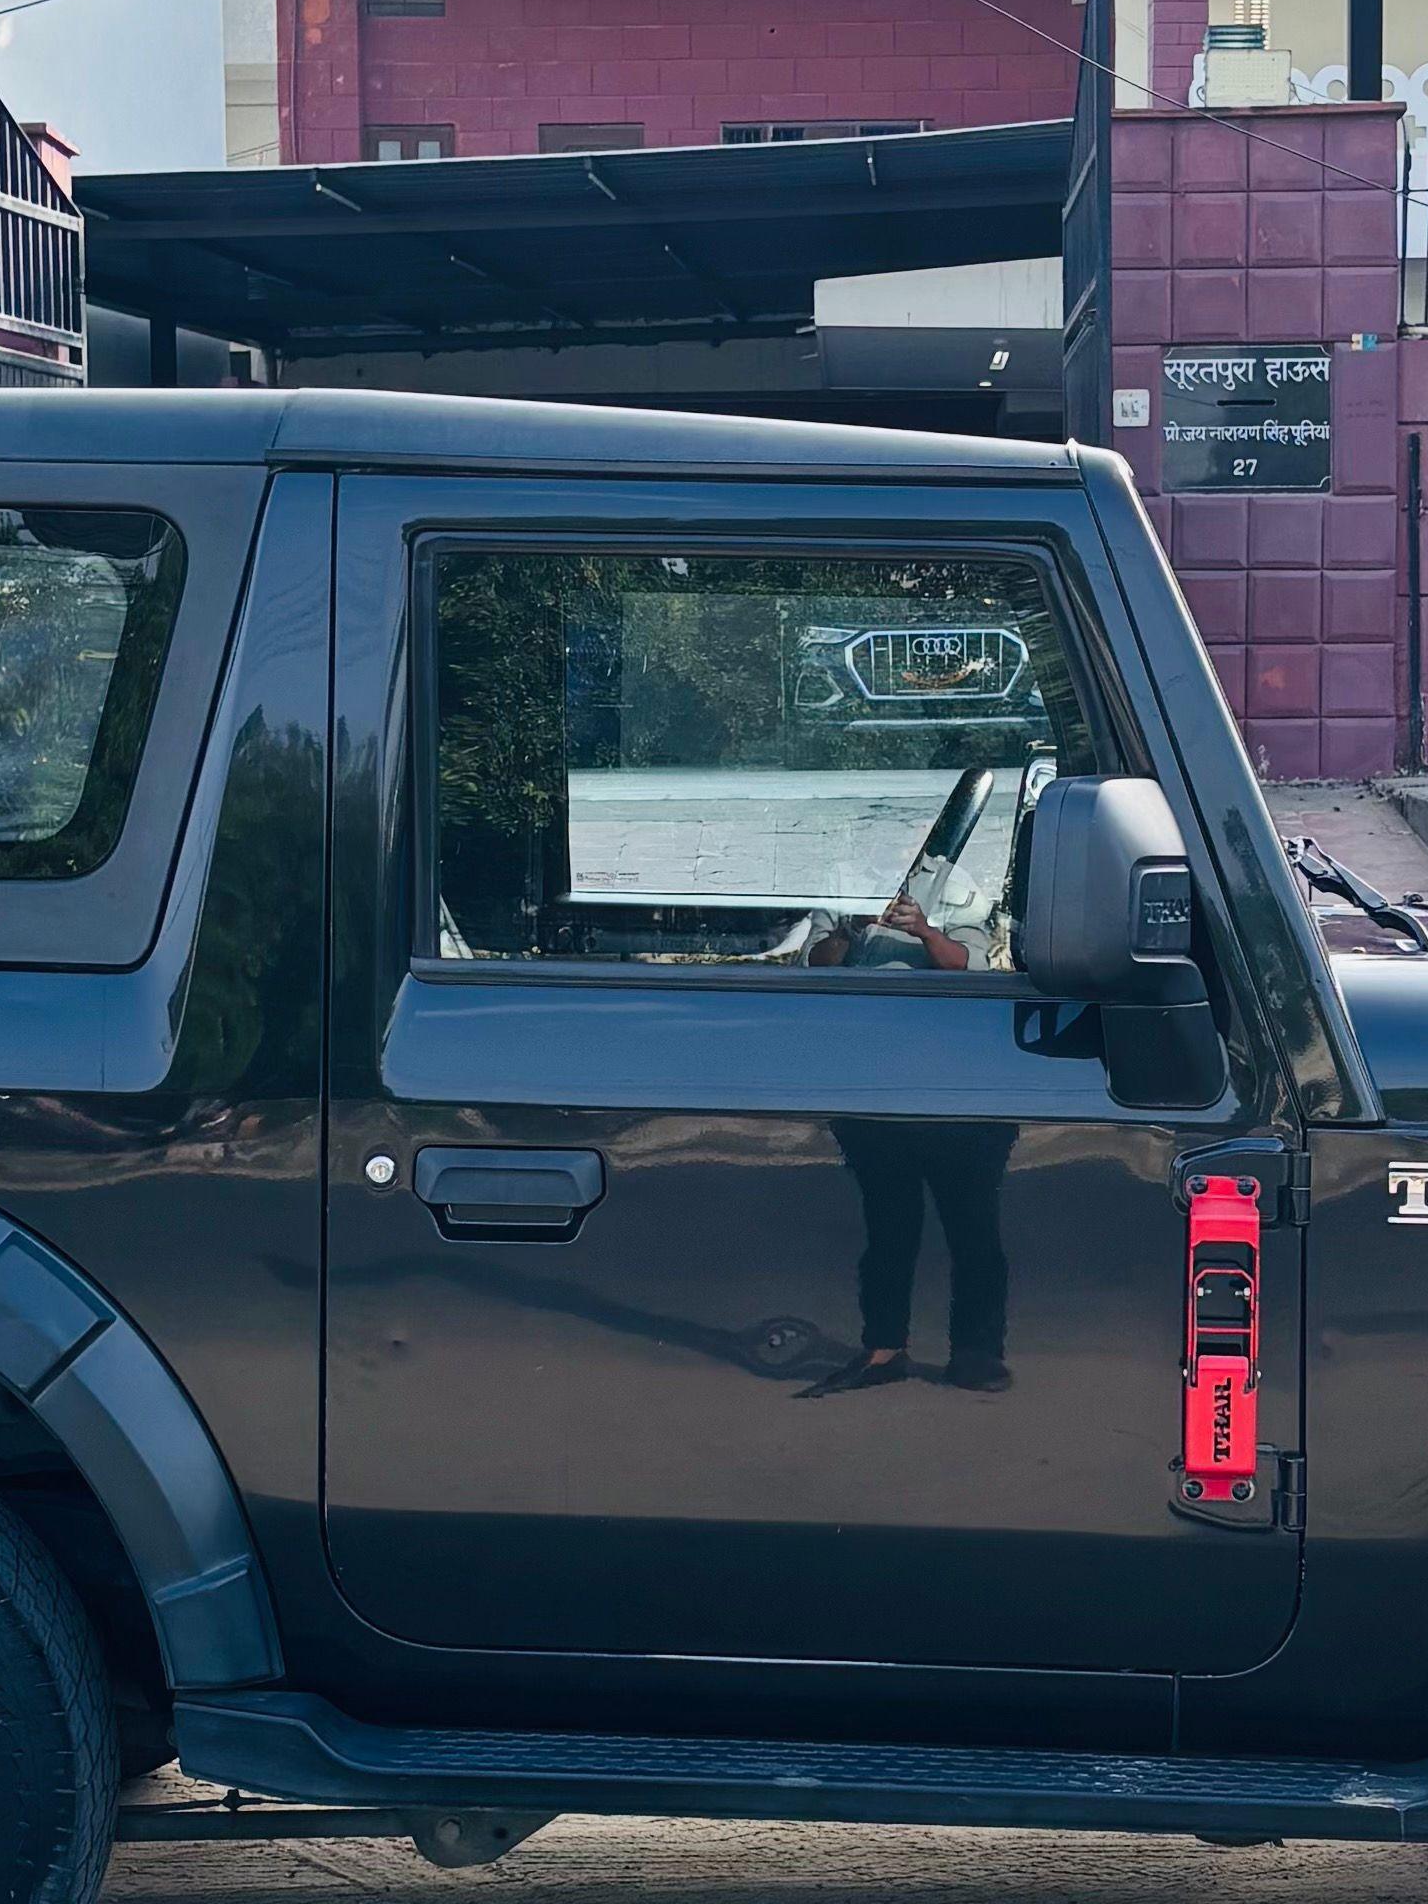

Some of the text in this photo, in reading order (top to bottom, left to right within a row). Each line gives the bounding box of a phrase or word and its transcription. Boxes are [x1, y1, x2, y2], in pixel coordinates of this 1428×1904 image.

[1164, 357, 1332, 391] सूरतपुरा हाऊस
[1209, 425, 1260, 443] नारायण
[1263, 419, 1289, 444] सिंह
[1233, 459, 1258, 476] 27
[1213, 1377, 1233, 1463] THAR
